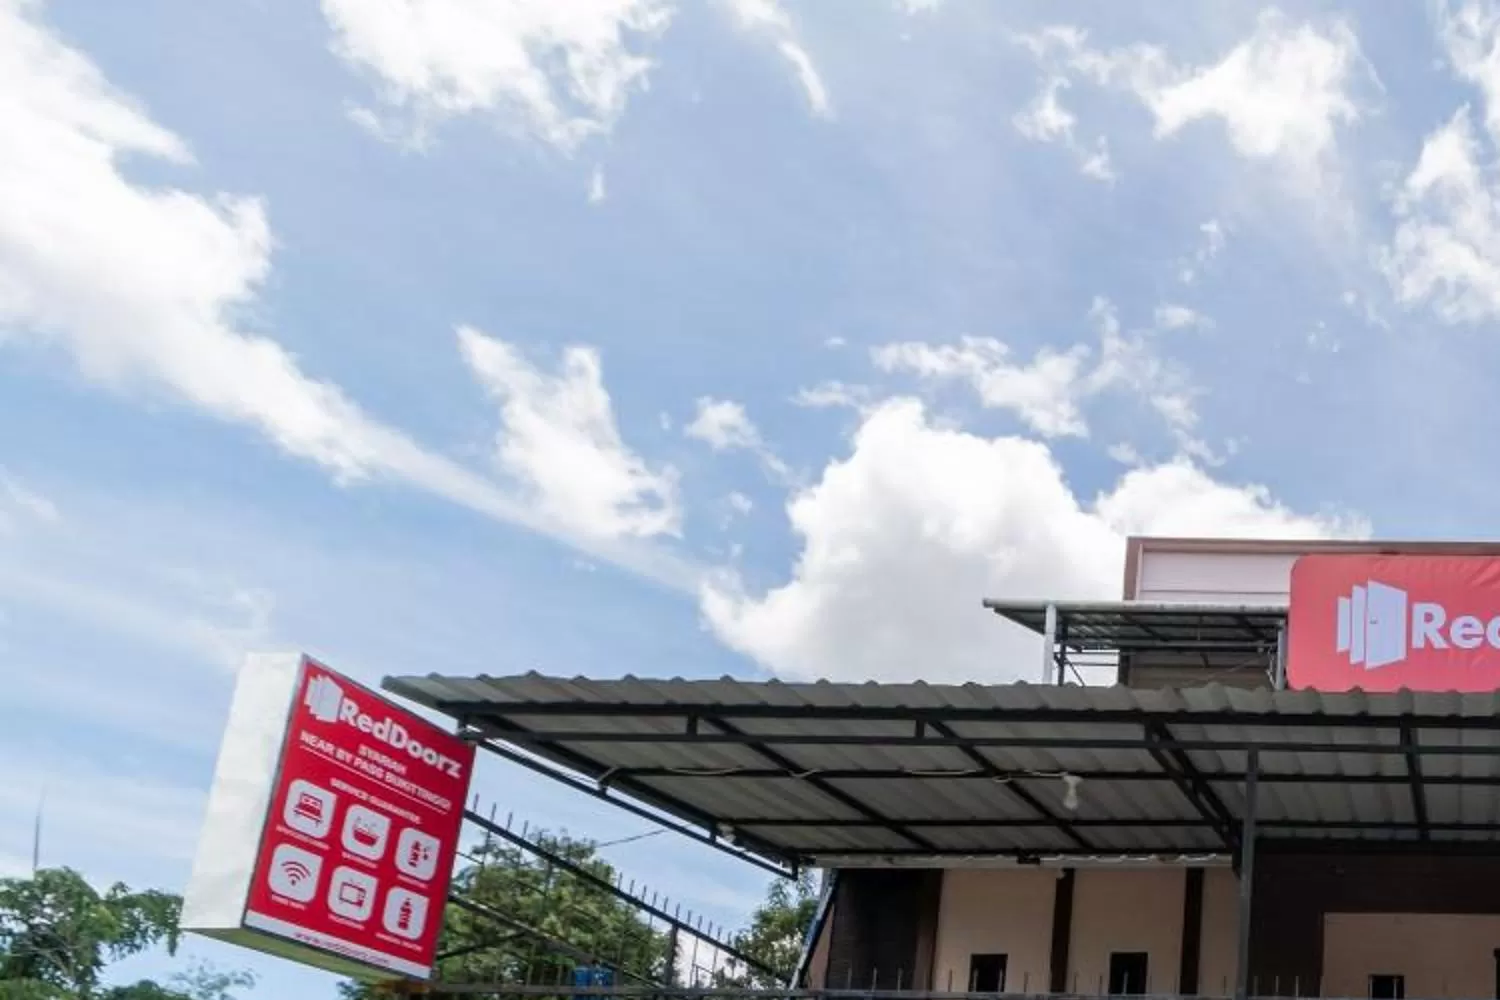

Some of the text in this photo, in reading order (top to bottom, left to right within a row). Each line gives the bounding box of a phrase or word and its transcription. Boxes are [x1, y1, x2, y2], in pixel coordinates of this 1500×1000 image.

[300, 730, 335, 756] NEAR
[335, 746, 354, 764] BY
[353, 757, 386, 779] PASS
[339, 697, 462, 779] RedDoorz
